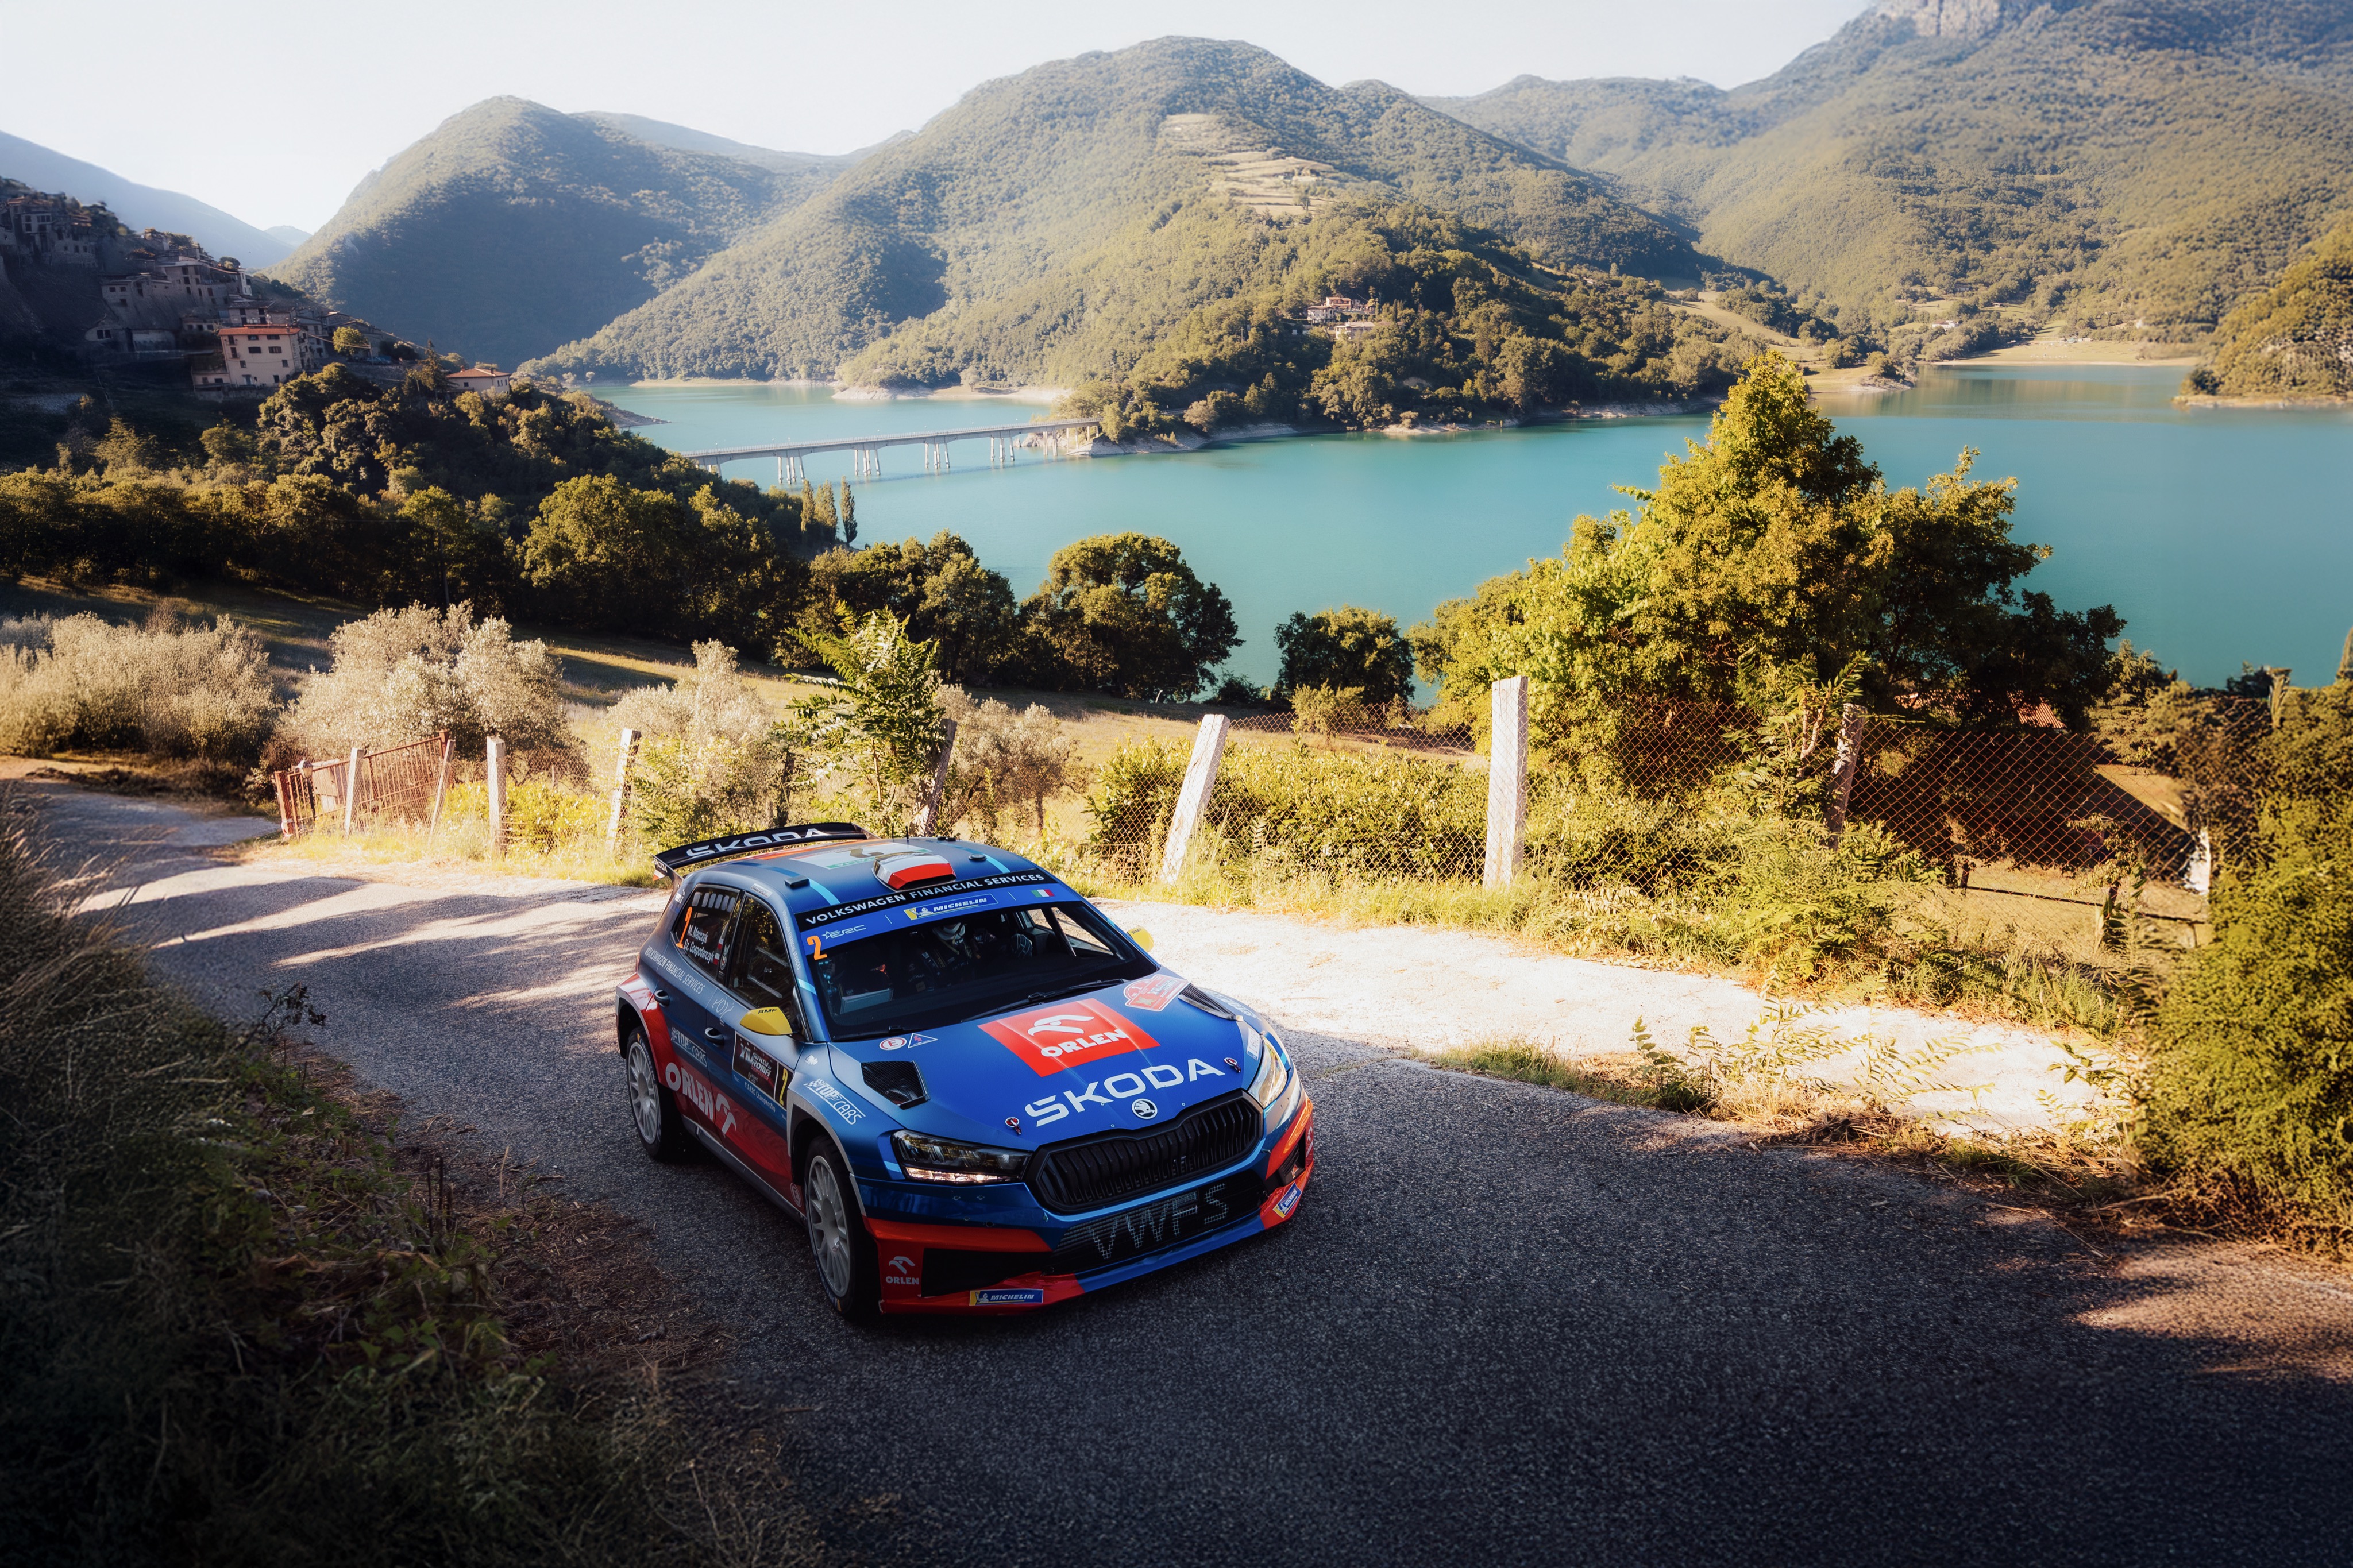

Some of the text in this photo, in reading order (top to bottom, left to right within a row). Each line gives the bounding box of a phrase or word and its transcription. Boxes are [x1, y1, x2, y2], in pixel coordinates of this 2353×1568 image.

[686, 828, 832, 857] SKODA
[653, 858, 668, 873] SKODA
[805, 874, 1045, 925] VOLKSWAGEN FINANCIAL SERVICES
[933, 897, 988, 912] MICHELIN
[693, 926, 709, 945] Marczyk
[807, 935, 828, 961] 2
[689, 941, 715, 964] Gospodarczyk
[788, 931, 796, 952] FINANCIAL
[793, 951, 801, 970] SERVICES
[645, 945, 705, 994] VOLKSWAGEN FINANCIAL SERVICES
[888, 1039, 898, 1048] E
[1040, 1028, 1130, 1057] ORLEN
[751, 1060, 771, 1077] ROMA
[753, 1052, 769, 1066] RALLY
[665, 1062, 715, 1121] ORLEN
[779, 1068, 788, 1106] 2
[1025, 1059, 1225, 1127] SKODA
[833, 1101, 862, 1125] CARS
[1284, 1188, 1298, 1207] MICHELIN
[1089, 1183, 1229, 1260] VWFS
[885, 1276, 920, 1285] ORLEN
